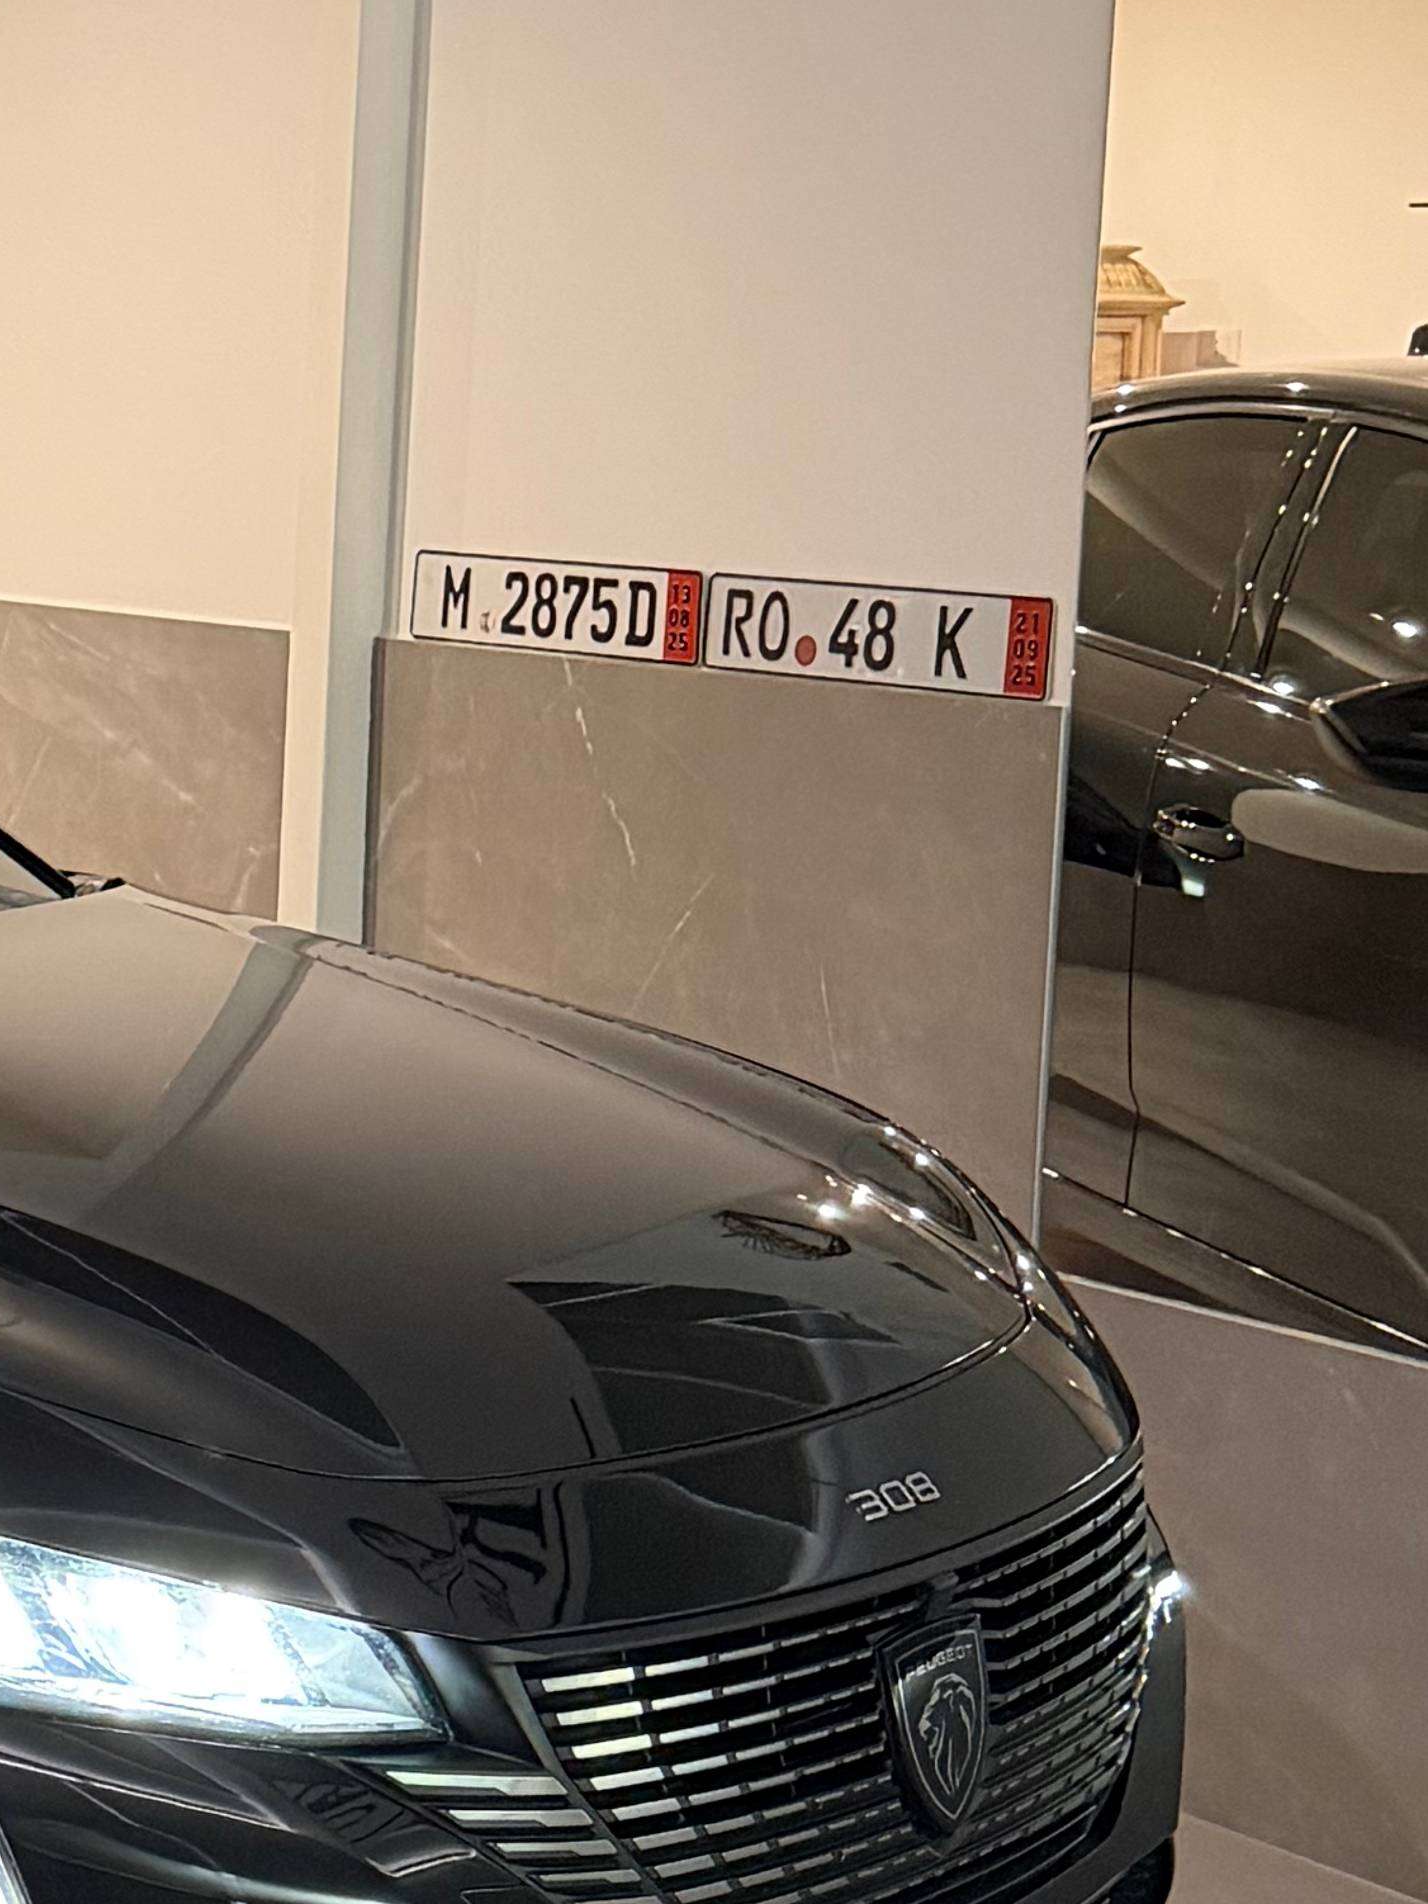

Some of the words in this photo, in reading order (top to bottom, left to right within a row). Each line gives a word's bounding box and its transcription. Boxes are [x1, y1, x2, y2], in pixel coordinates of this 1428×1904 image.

[672, 584, 691, 604] 13
[442, 564, 471, 629] M
[501, 571, 657, 647] 2875D
[669, 608, 690, 628] 08
[1016, 612, 1039, 634] 21
[667, 631, 689, 651] 25
[722, 589, 789, 661] RO
[828, 598, 896, 671] 48
[934, 605, 974, 680] K
[1013, 638, 1039, 661] 09
[1012, 664, 1036, 686] 25
[845, 1471, 941, 1521] 308
